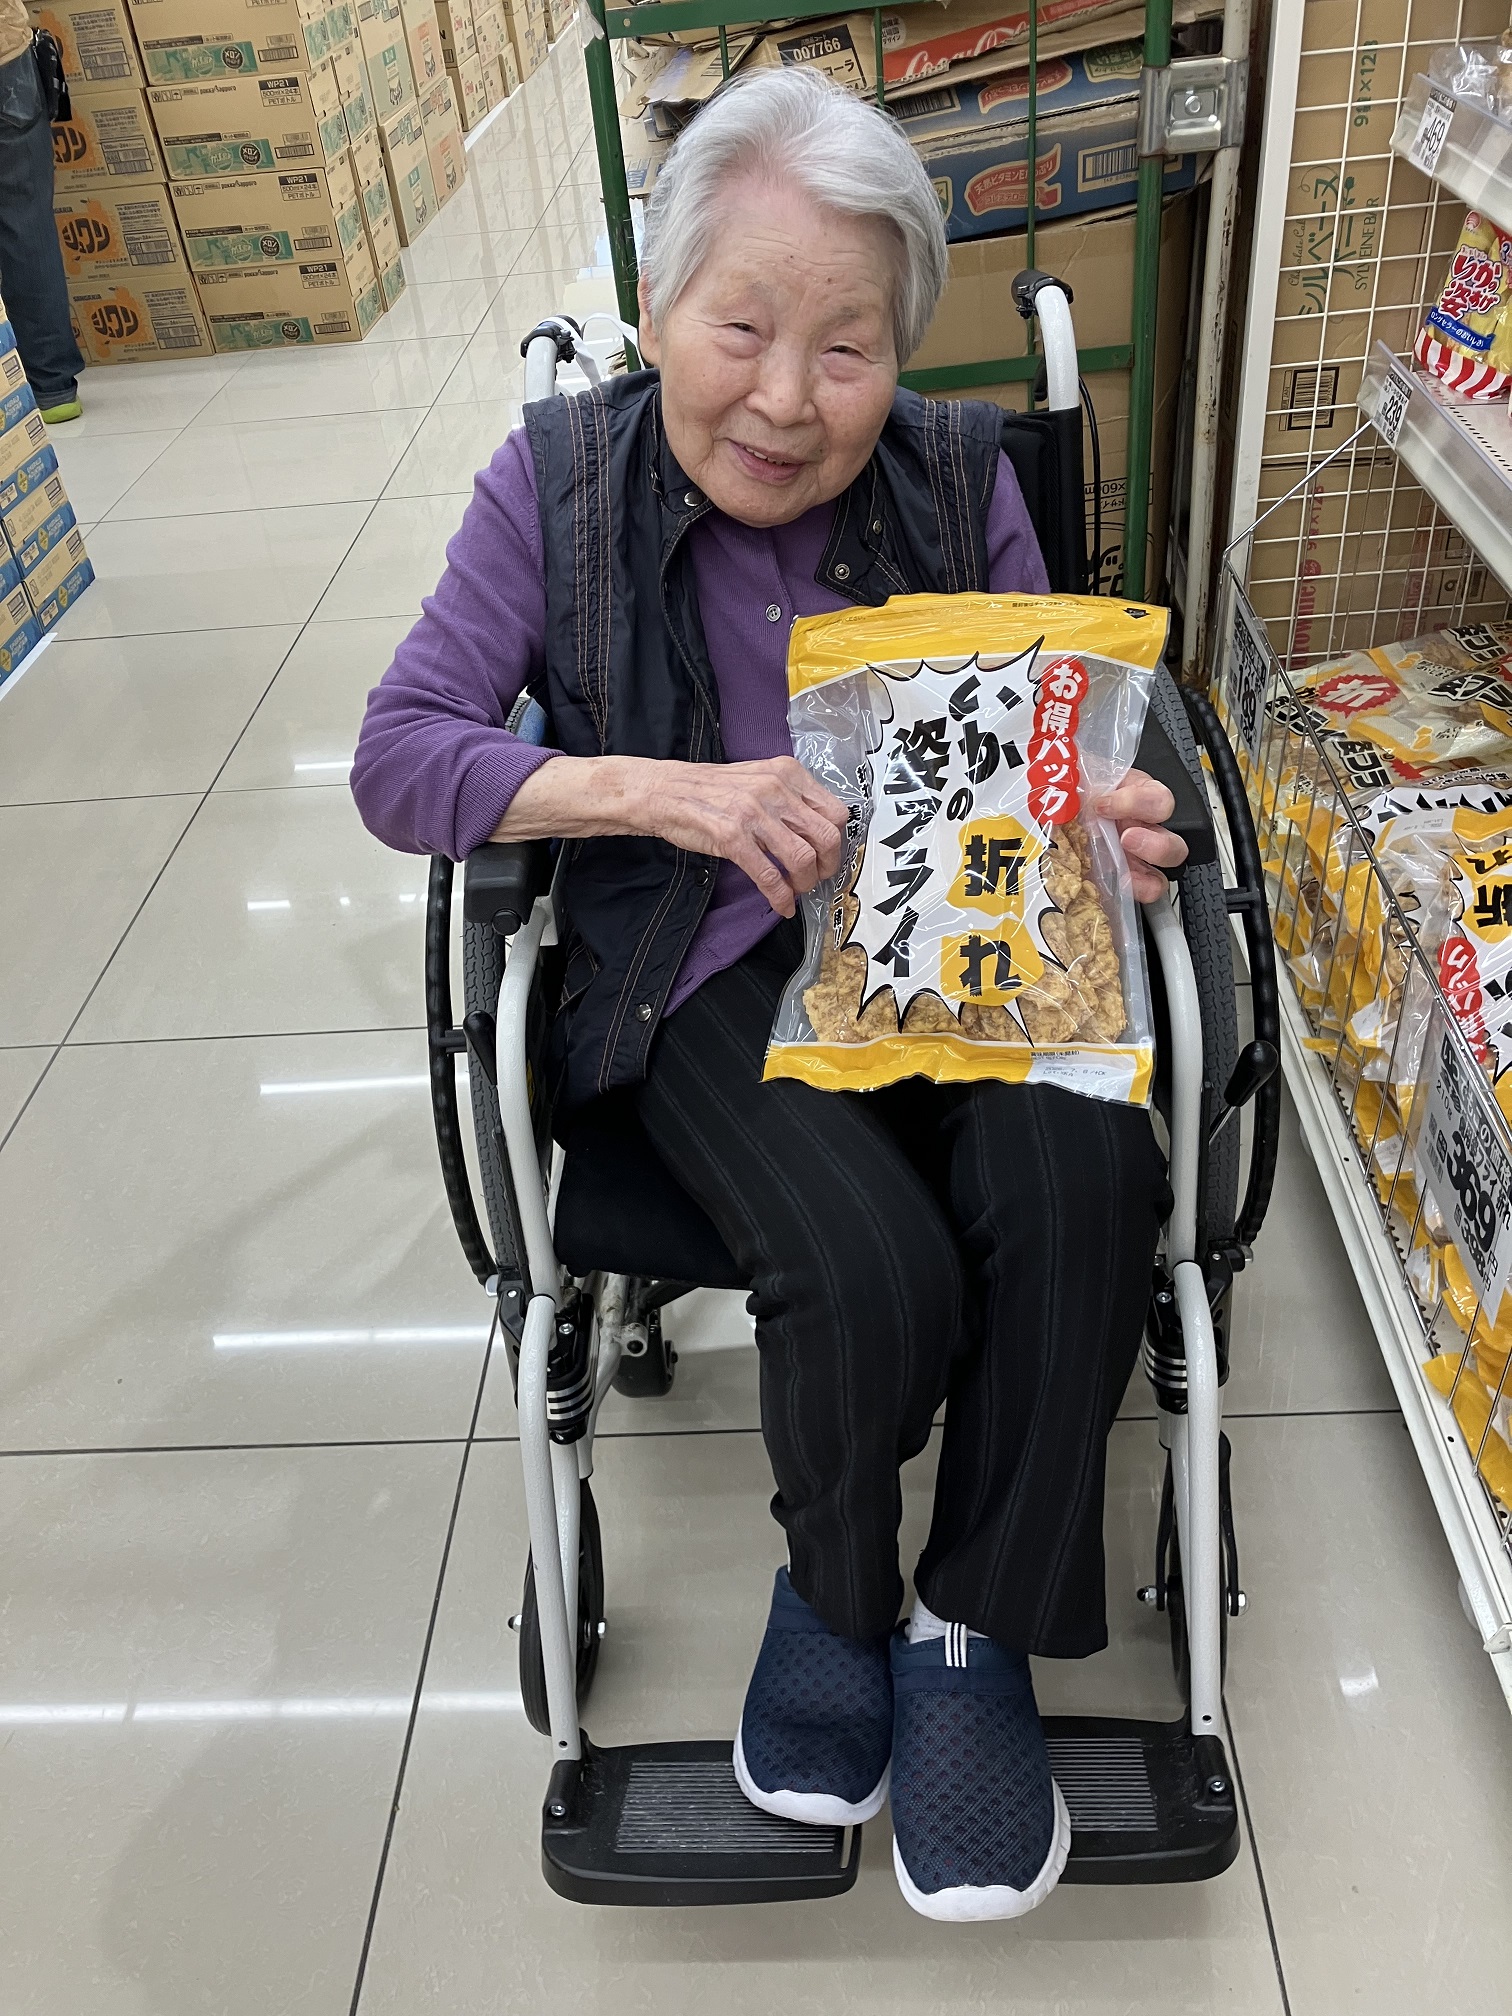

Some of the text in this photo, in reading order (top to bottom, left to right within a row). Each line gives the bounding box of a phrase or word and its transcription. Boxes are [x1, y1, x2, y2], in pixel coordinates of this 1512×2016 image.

[793, 37, 841, 62] 007766
[266, 79, 289, 88] WP21
[823, 59, 855, 77] コーラ
[286, 175, 308, 184] WP21
[974, 159, 1055, 195] 天然ビタミンEぷり
[306, 264, 328, 272] WP21
[1385, 395, 1403, 431] 239
[1085, 481, 1126, 496] ×60m
[1034, 662, 1085, 817] お得パック
[872, 715, 952, 978] 姿フライ
[961, 833, 1027, 998] 折れ
[1442, 1036, 1512, 1191] いつでもこの価格
[1447, 1130, 1499, 1278] 369 円
[1461, 1217, 1486, 1278] 398
